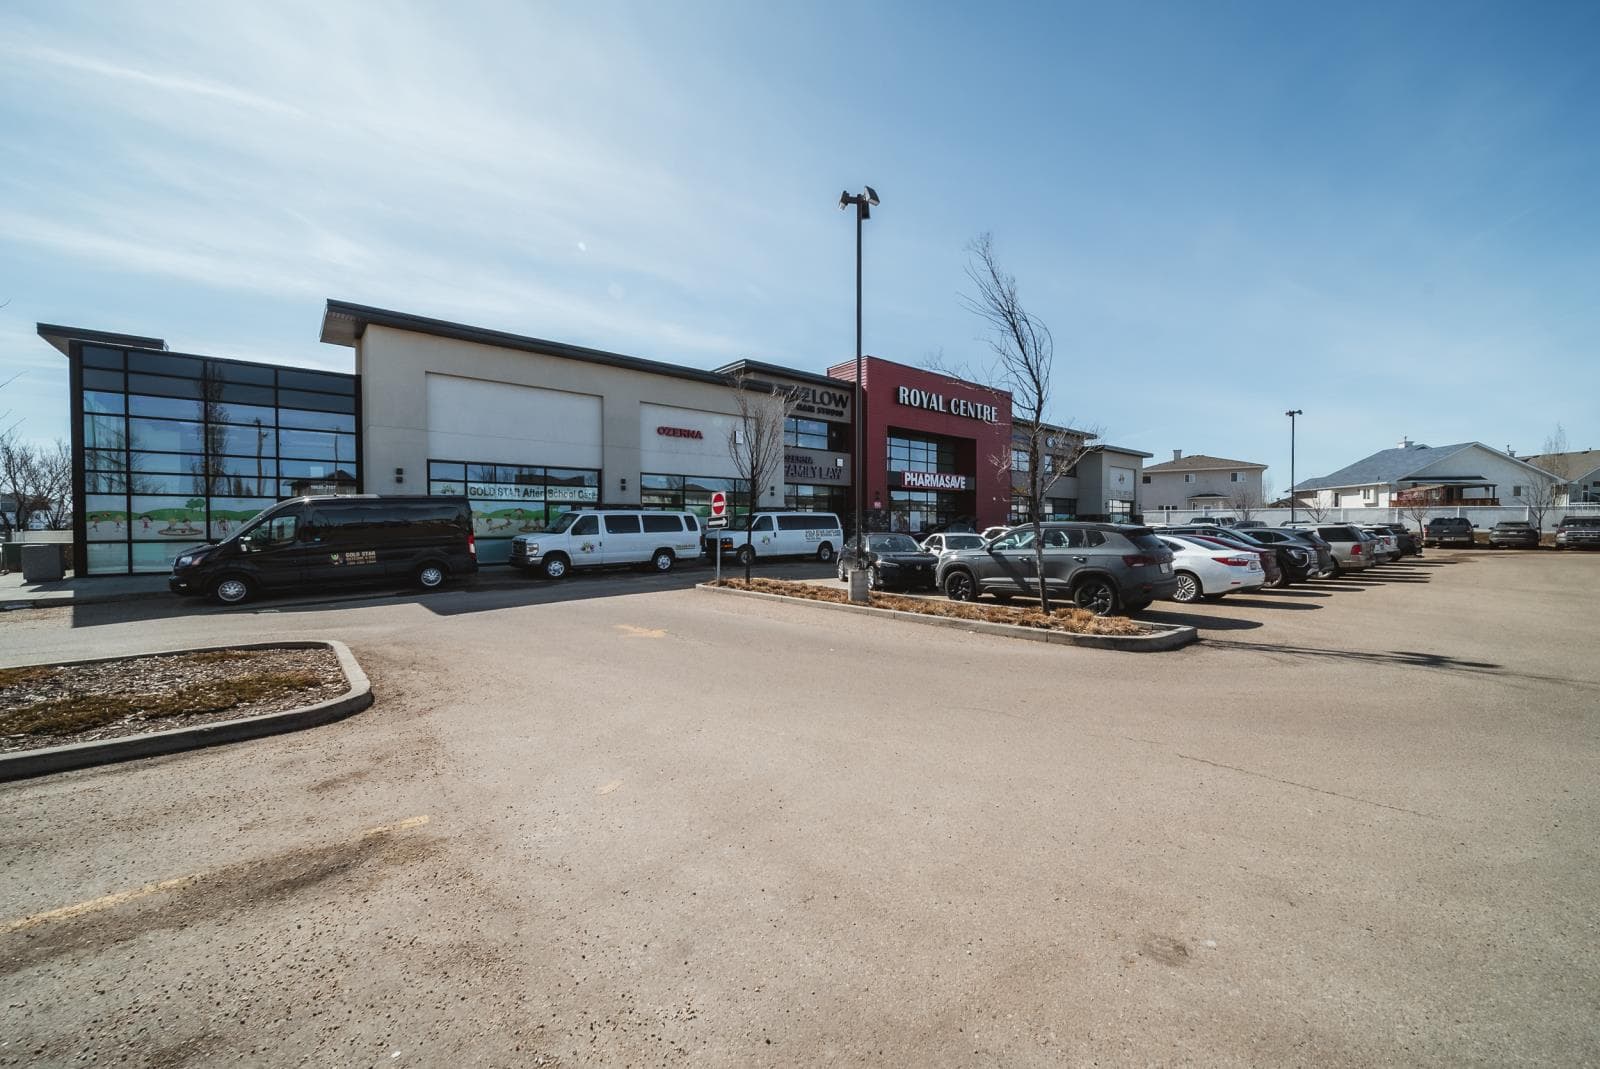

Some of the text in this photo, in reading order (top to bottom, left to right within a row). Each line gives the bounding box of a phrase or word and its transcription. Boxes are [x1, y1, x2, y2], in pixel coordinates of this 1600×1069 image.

[899, 385, 999, 423] ROYAL CENTRE
[656, 426, 704, 440] OZERNA
[904, 471, 966, 489] PHARMASAVE
[469, 486, 495, 497] GOLD
[522, 487, 545, 498] After
[547, 489, 576, 499] School
